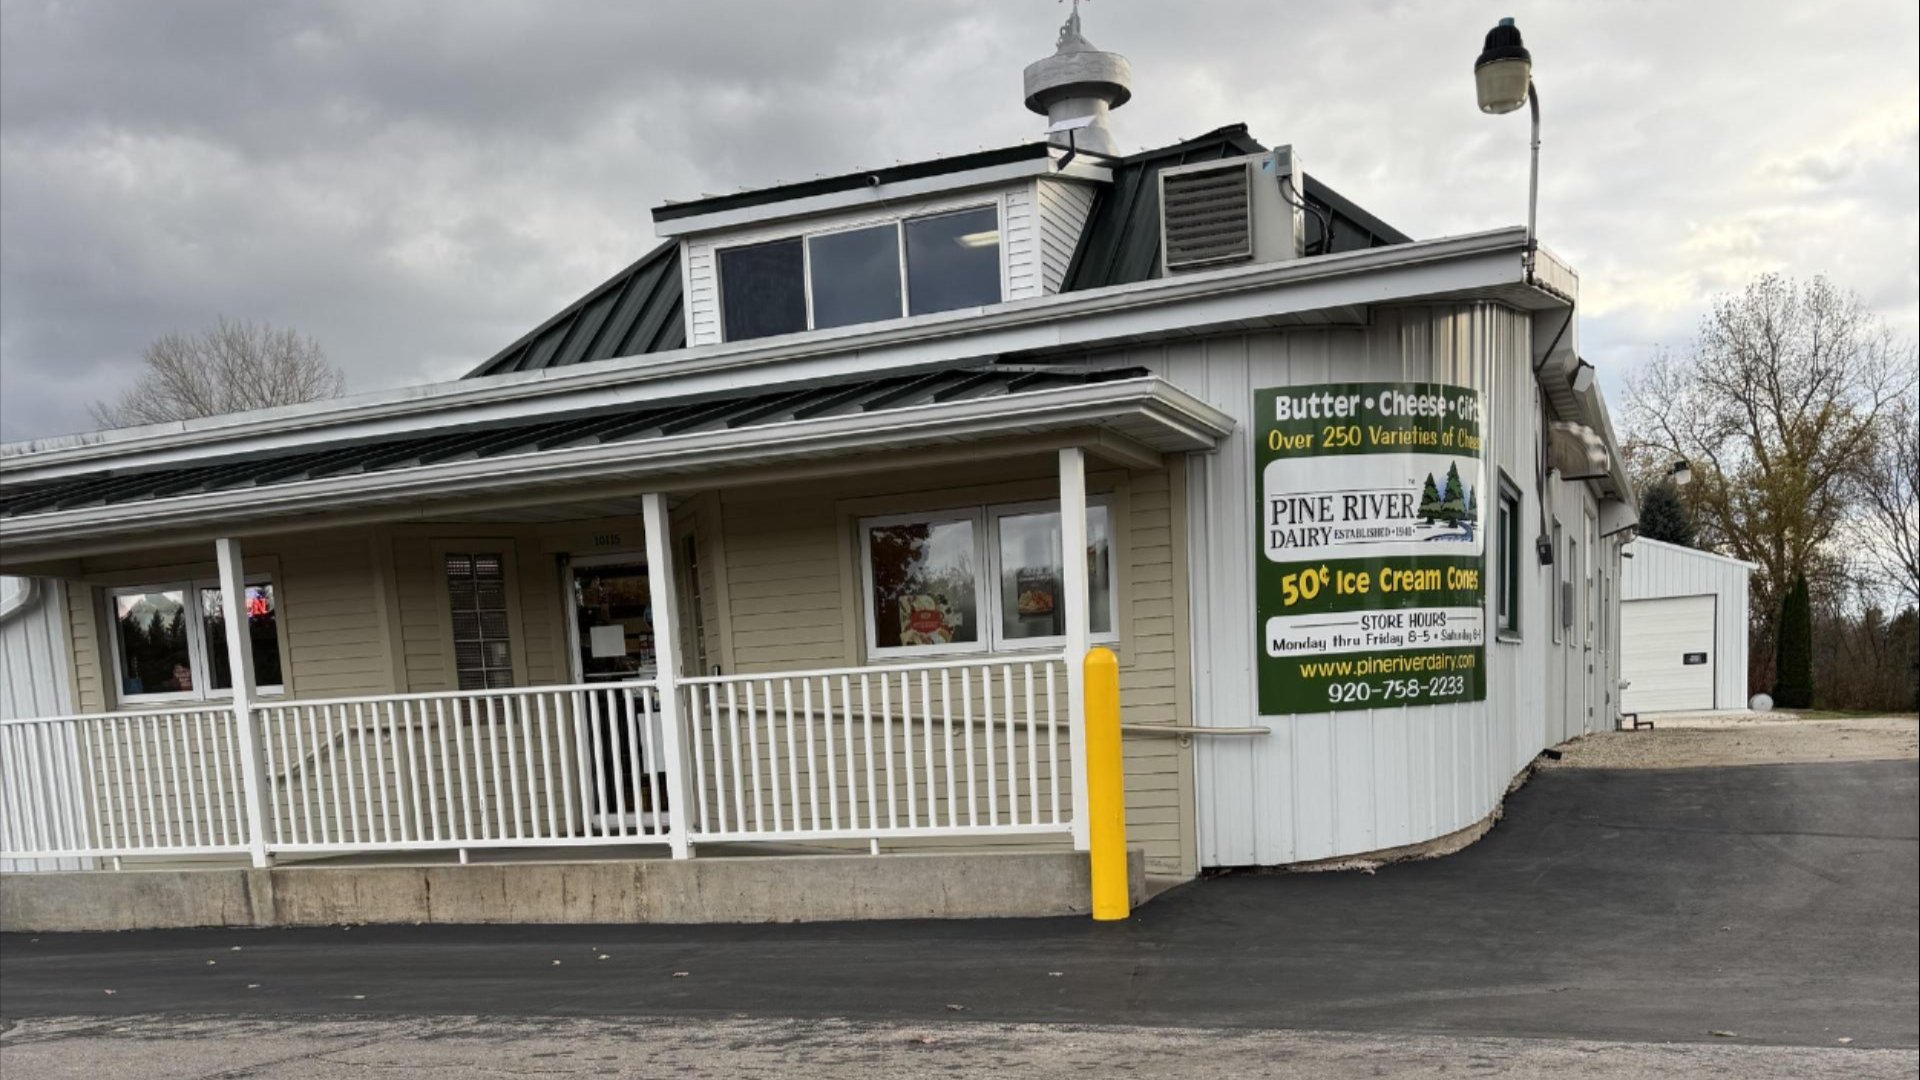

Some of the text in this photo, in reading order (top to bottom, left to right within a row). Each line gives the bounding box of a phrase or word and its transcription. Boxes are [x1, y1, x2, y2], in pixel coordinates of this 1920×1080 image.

[1276, 391, 1361, 421] Butter
[1379, 390, 1447, 417] Cheese
[1269, 429, 1313, 450] Over
[1323, 426, 1362, 448] 250
[1368, 425, 1437, 446] Varieties
[1442, 426, 1454, 446] of
[1271, 492, 1415, 525] PINE RIVER
[1270, 526, 1332, 549] DAIRY
[1334, 526, 1391, 539] ESTABLISHED
[1336, 570, 1370, 594] Ice
[1379, 567, 1441, 592] Cream
[1447, 566, 1478, 590] Cones
[1361, 612, 1446, 631] STORE HOURS
[1273, 637, 1326, 651] Monday
[1333, 635, 1360, 647] thru
[1366, 632, 1403, 646] Friday
[1408, 630, 1431, 642] 8-5
[1300, 653, 1475, 678] www.pineriverdairy.com
[1328, 676, 1464, 703] 920-758-2233
